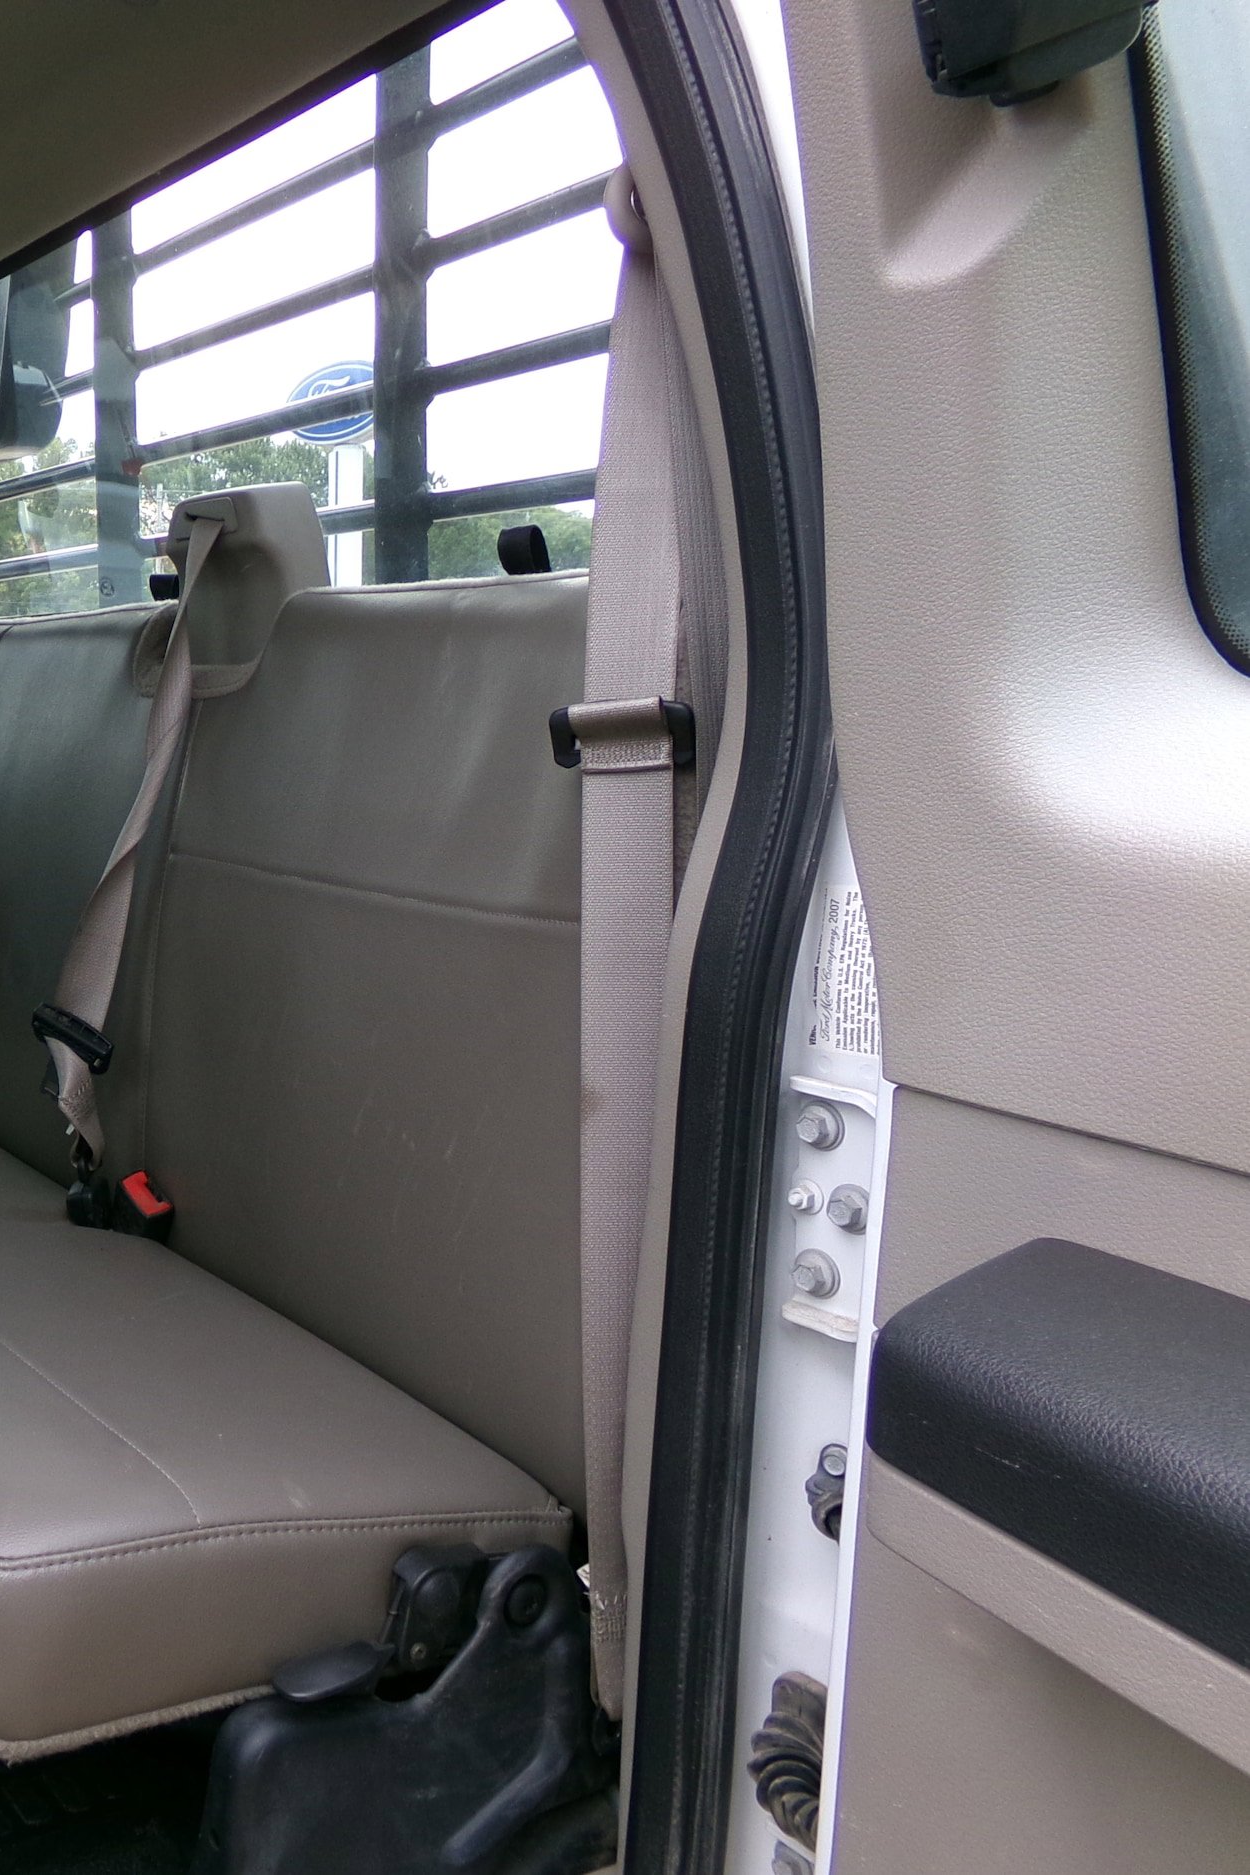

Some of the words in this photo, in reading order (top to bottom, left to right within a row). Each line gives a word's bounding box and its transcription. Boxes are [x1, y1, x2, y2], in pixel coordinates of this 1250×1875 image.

[828, 898, 840, 924] 2007
[840, 920, 849, 951] Regulations
[848, 931, 856, 947] Heavy
[820, 981, 833, 1019] Motor
[819, 1013, 831, 1041] Ford
